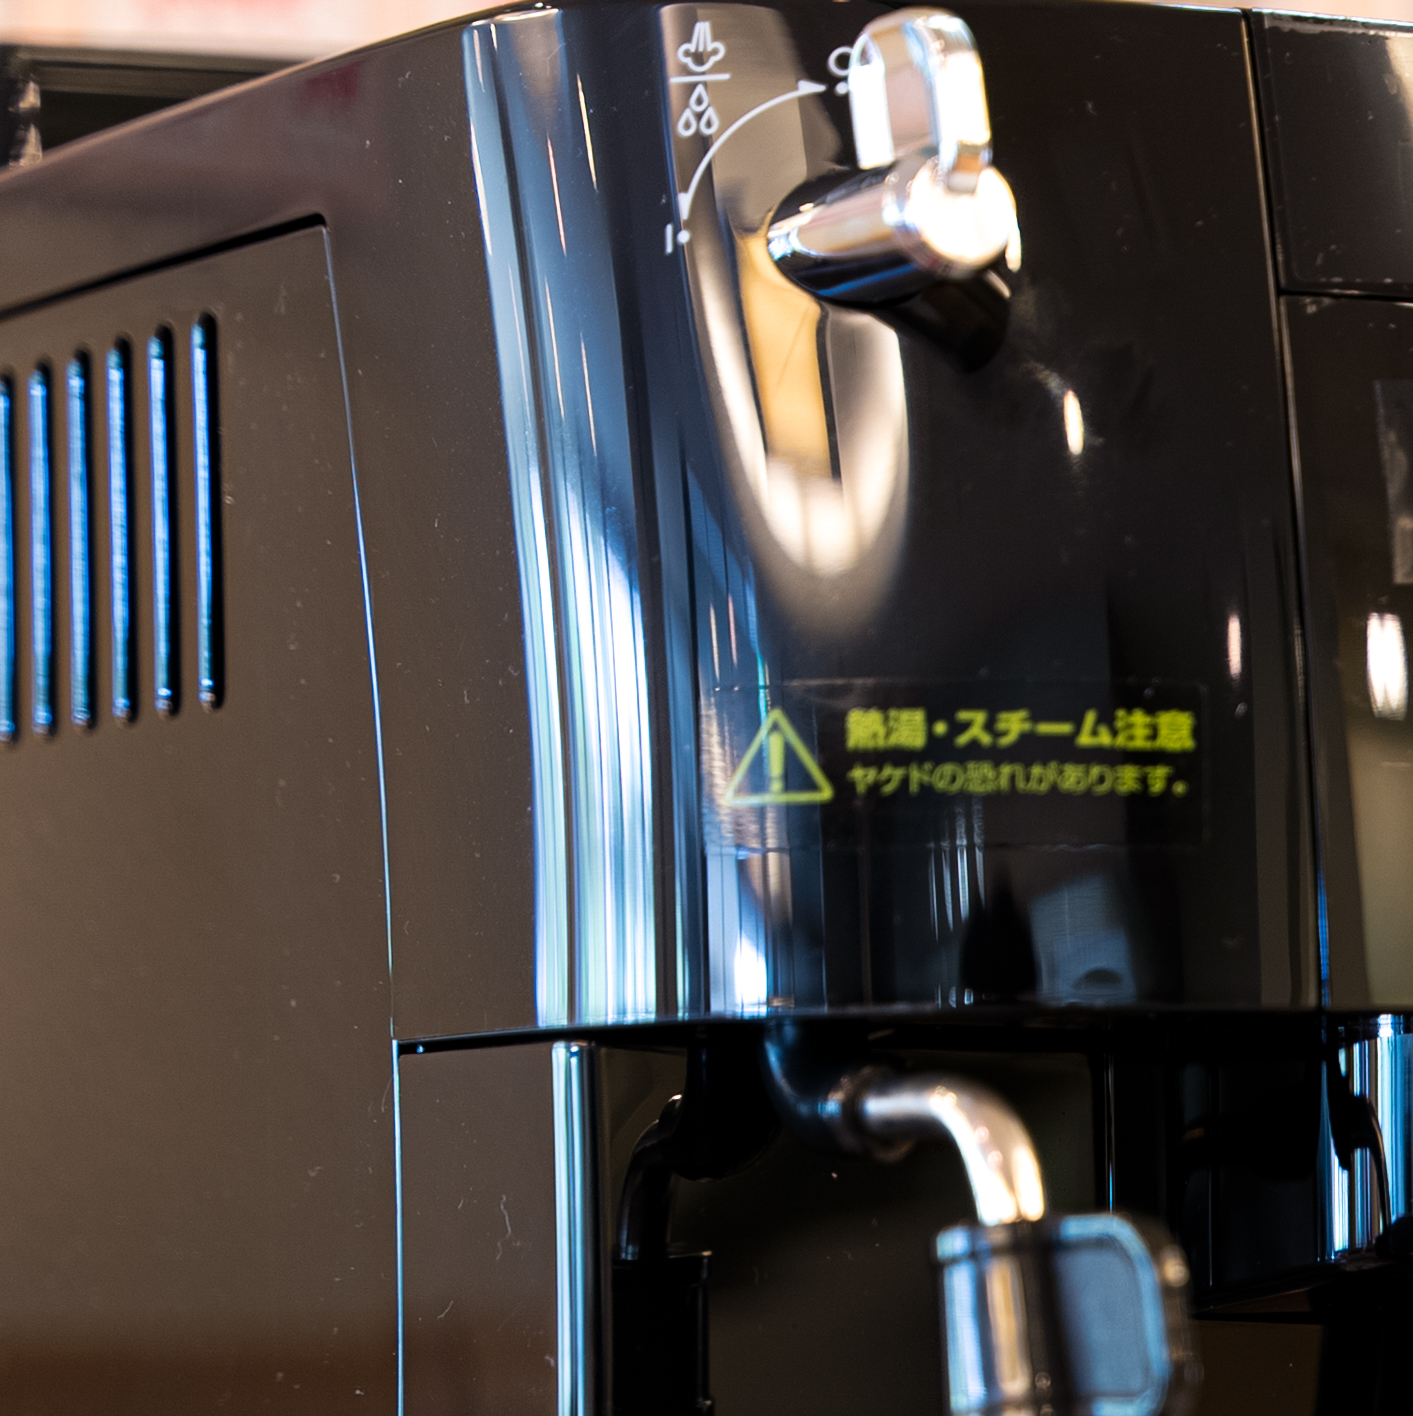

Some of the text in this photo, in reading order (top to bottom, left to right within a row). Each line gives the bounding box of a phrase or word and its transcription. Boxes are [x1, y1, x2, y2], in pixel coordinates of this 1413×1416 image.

[846, 708, 1196, 751] 熱湯・スチーム注意
[847, 760, 1188, 796] ヤケドの恐れがあります。
